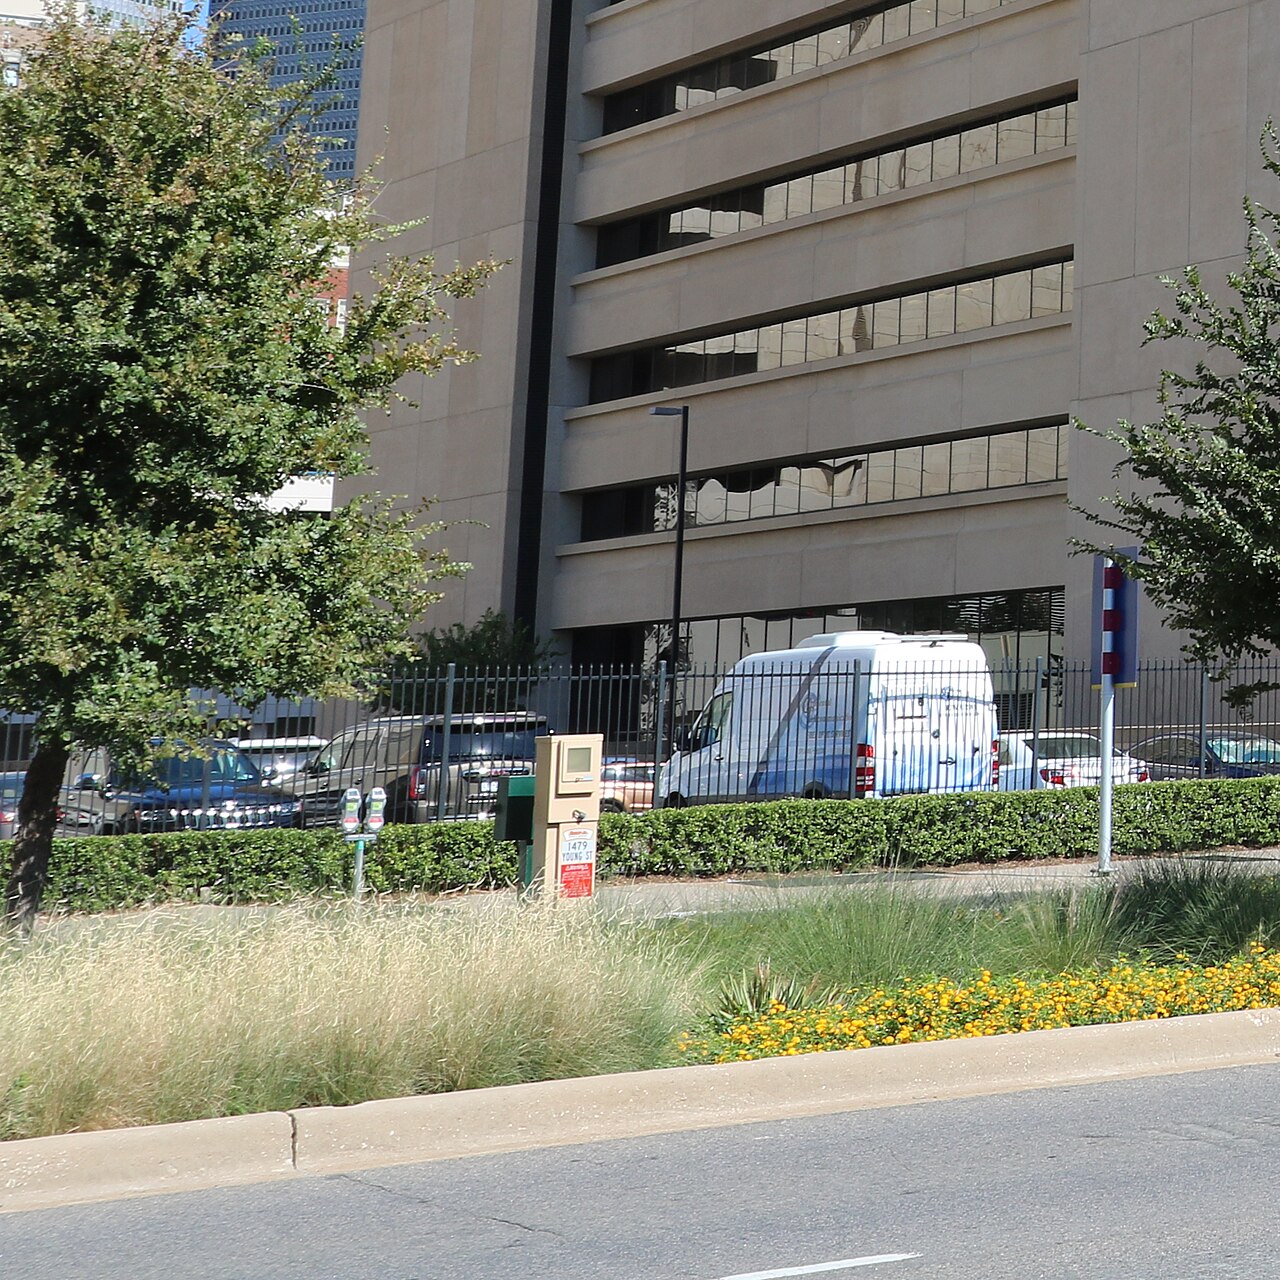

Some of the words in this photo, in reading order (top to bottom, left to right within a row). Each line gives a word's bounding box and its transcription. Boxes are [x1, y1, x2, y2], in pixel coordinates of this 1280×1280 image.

[567, 841, 588, 851] 1479
[562, 852, 583, 862] YOUNG
[585, 851, 593, 860] ST
